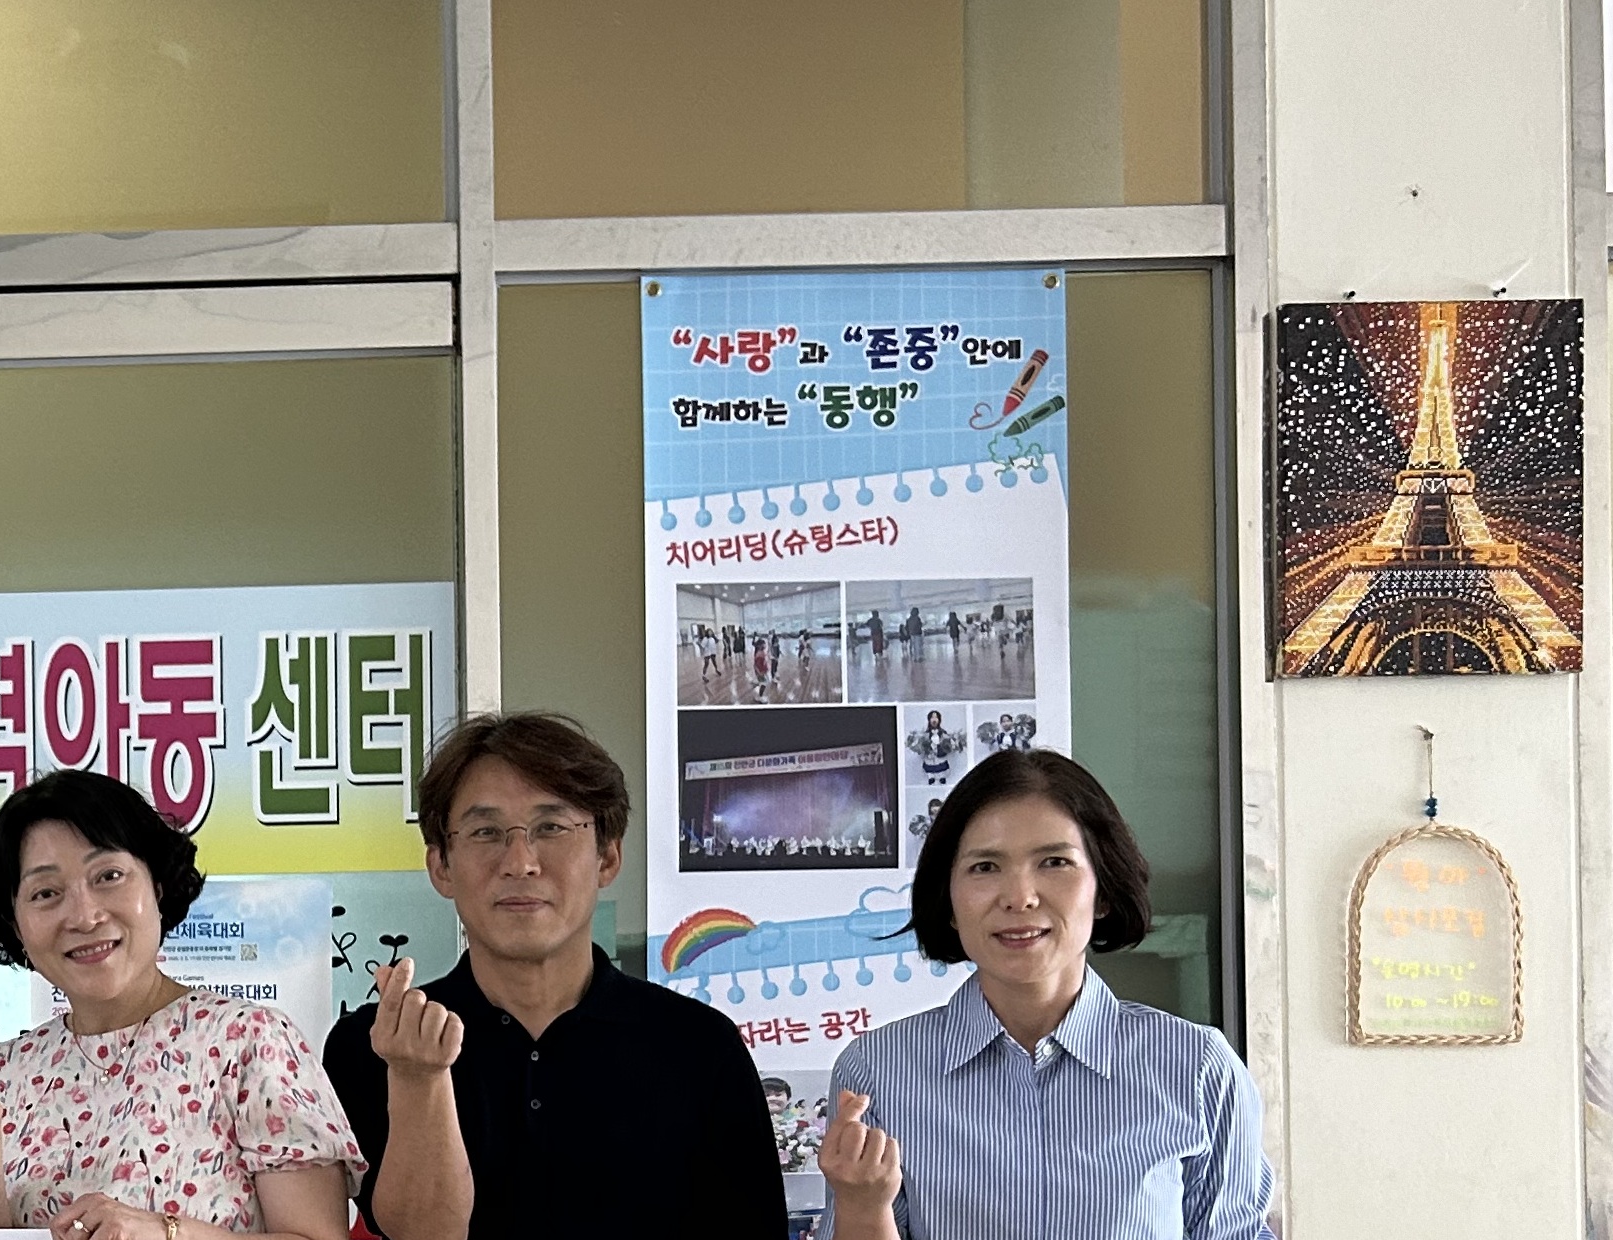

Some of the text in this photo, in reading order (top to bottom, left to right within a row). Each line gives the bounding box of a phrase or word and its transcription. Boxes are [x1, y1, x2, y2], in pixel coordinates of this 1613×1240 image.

[673, 398, 788, 427] 함께하는
[666, 516, 900, 568] 치어리딩(슈팅스타)
[246, 629, 432, 824] 센터
[819, 1008, 872, 1040] 공간
